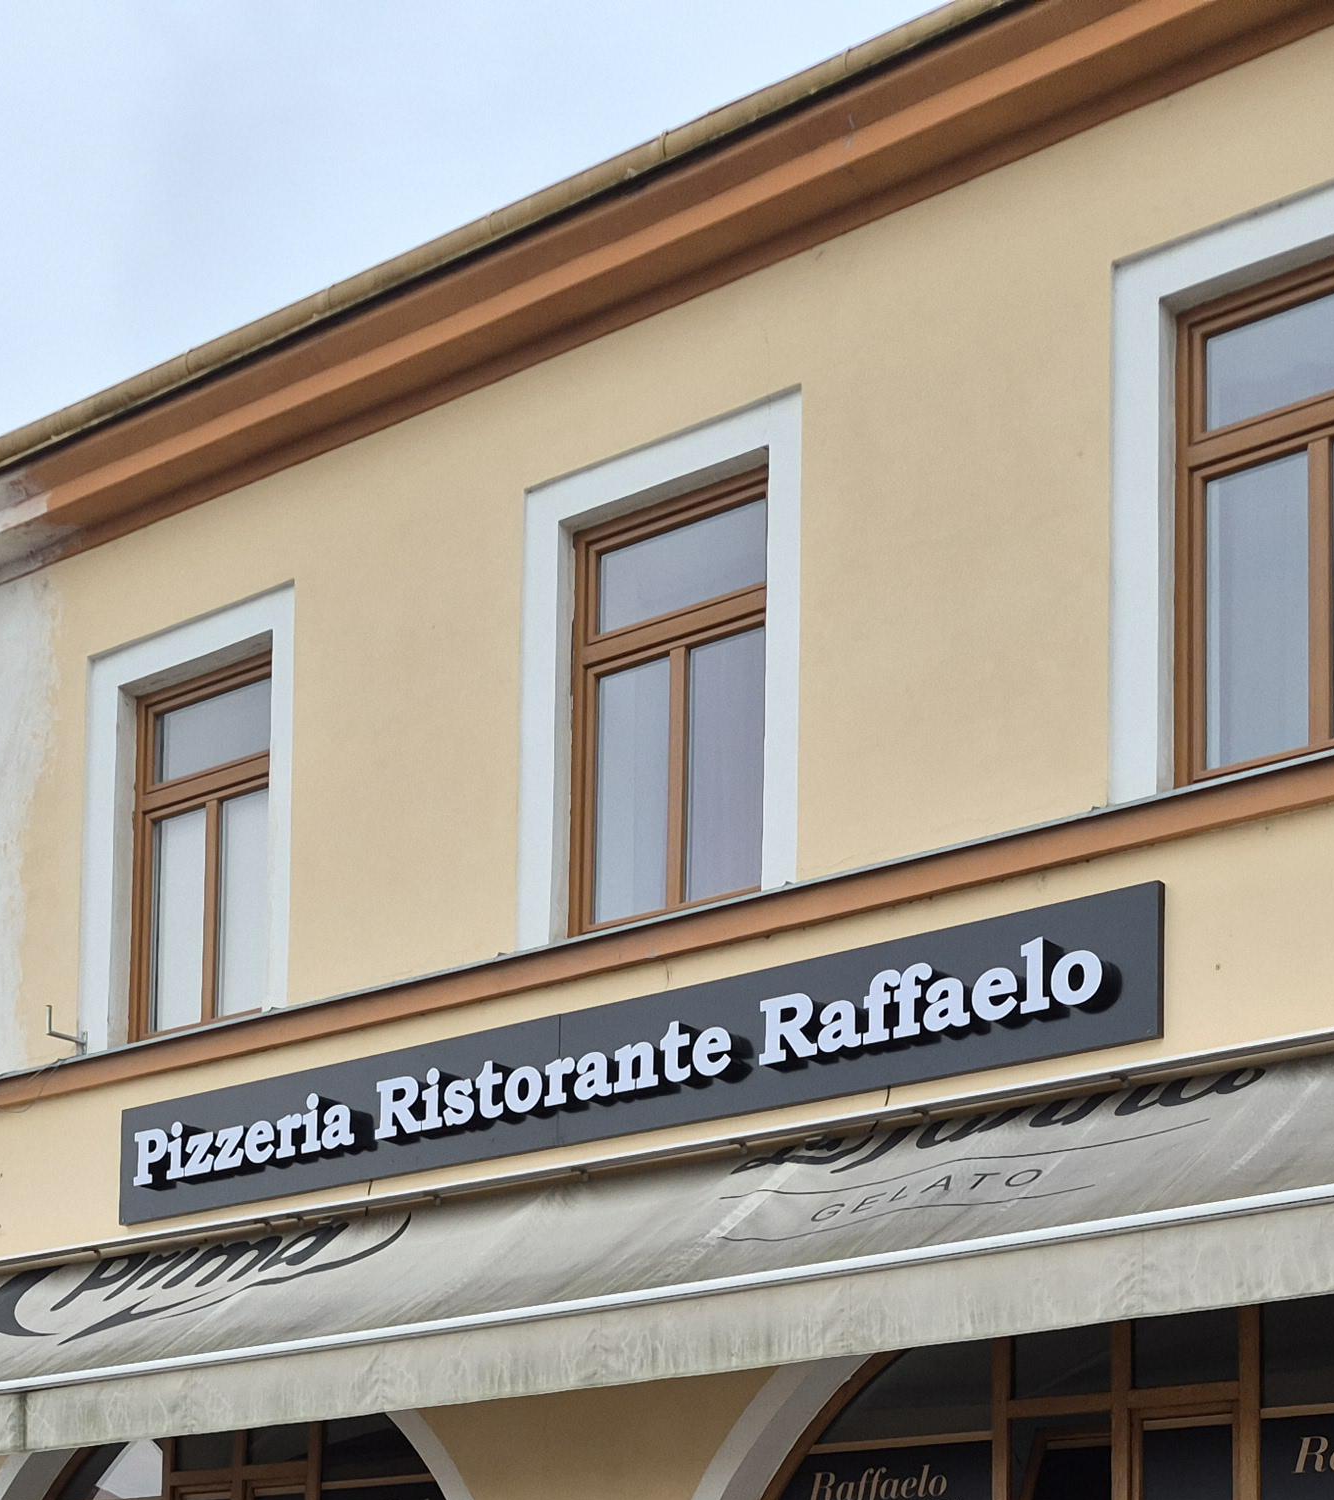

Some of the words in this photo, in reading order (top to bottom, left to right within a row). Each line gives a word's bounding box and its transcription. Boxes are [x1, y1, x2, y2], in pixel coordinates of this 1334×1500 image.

[133, 1093, 355, 1187] Pizzeria
[374, 1020, 731, 1142] Ristorante
[758, 936, 1103, 1066] Raffaelo
[811, 1169, 1042, 1222] GELATO
